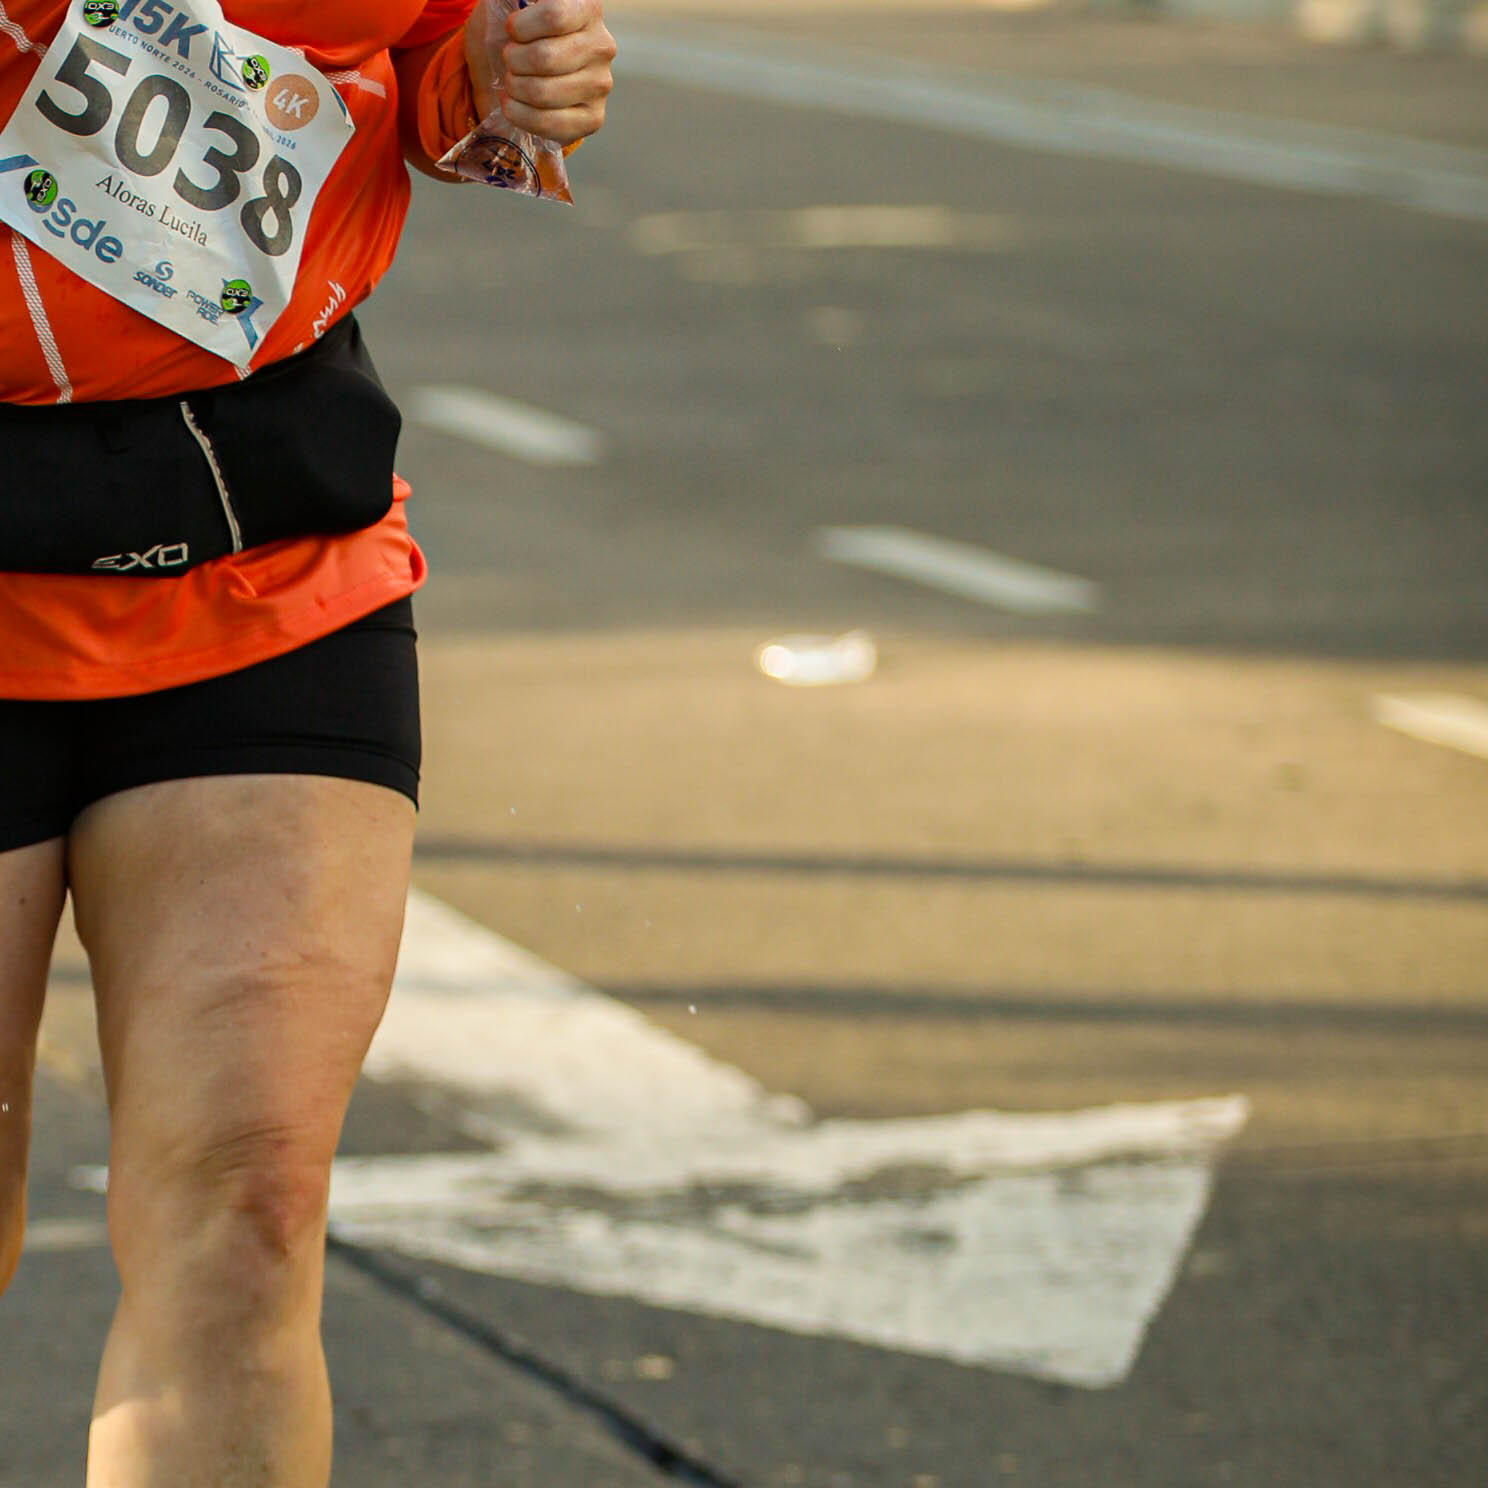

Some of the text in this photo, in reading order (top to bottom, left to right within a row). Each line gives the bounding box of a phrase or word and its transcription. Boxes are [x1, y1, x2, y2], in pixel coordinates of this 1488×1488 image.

[108, 24, 139, 45] UERTO
[140, 40, 171, 63] NORTE
[272, 88, 309, 120] 4K
[35, 32, 302, 256] 5038
[25, 194, 124, 263] sde
[95, 175, 209, 247] Aloras Lucila
[91, 542, 189, 572] EXO
